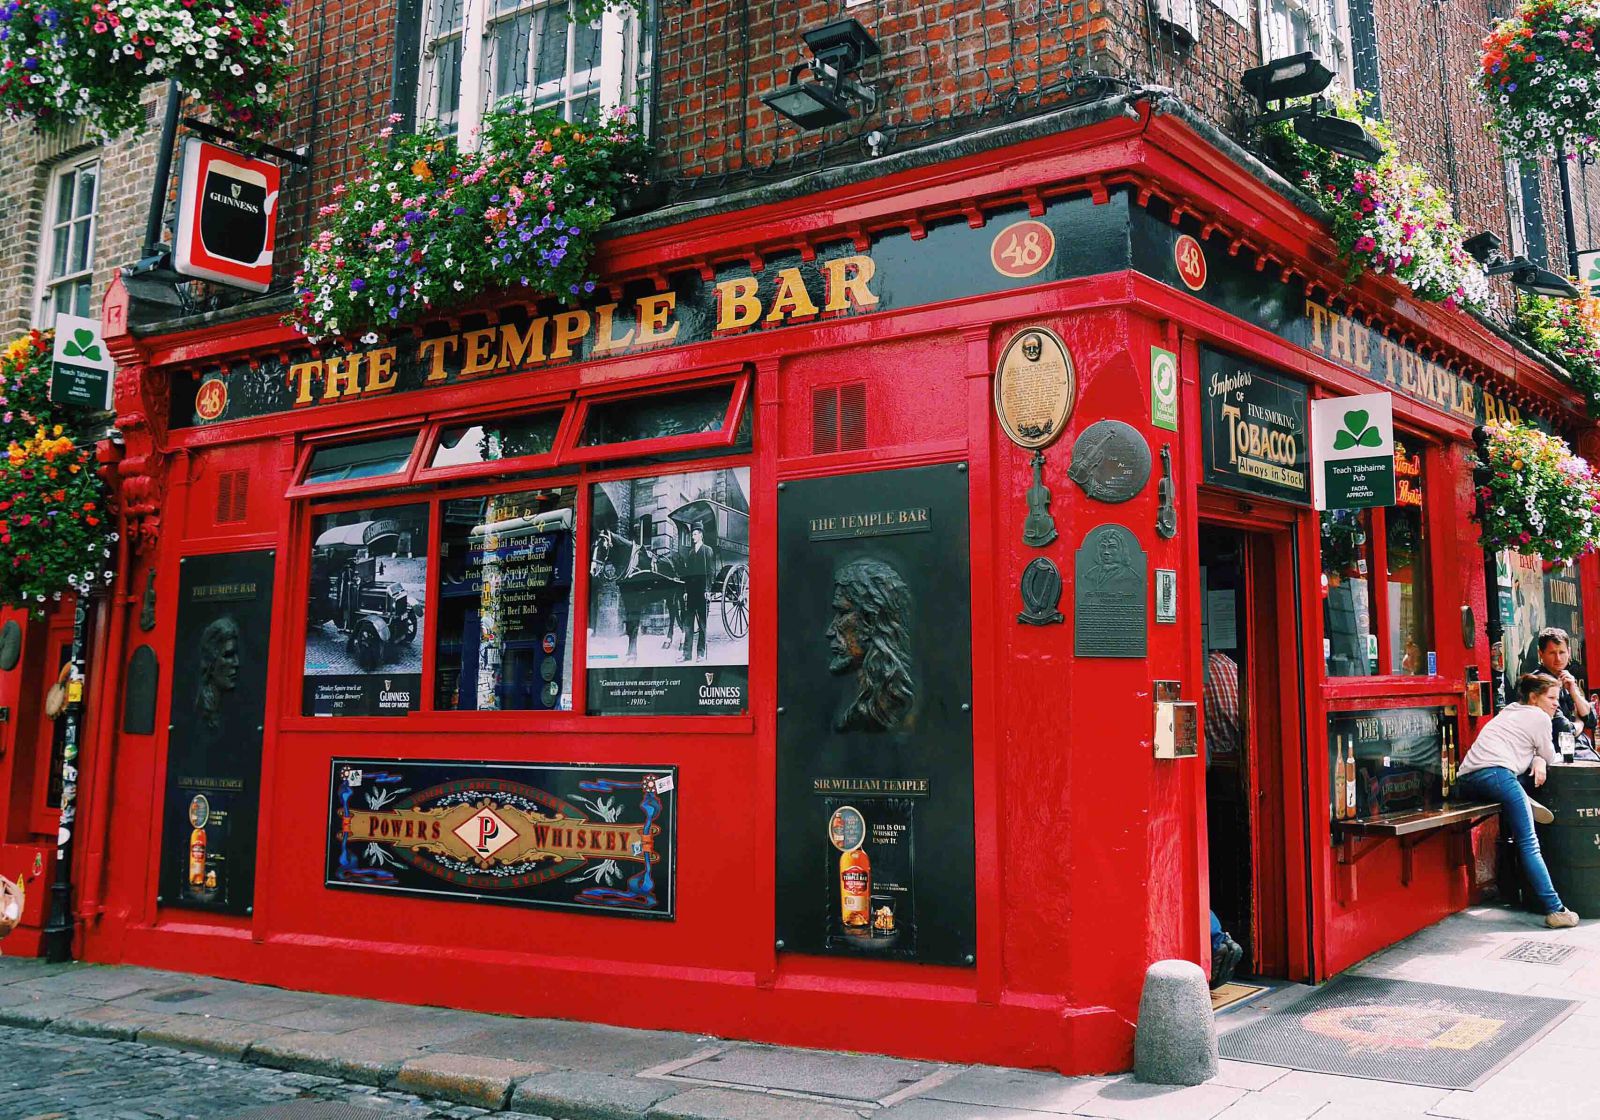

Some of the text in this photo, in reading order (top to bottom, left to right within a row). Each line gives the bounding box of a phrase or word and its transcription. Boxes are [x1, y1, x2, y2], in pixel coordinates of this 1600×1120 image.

[210, 192, 259, 214] GUINNESS
[1001, 233, 1043, 268] 48
[1181, 242, 1200, 278] 48
[289, 255, 879, 404] THE TEMPLE BAR
[1306, 299, 1520, 426] THE TEMPLE BAR
[1209, 370, 1252, 403] Importers
[201, 387, 220, 413] 48
[1236, 392, 1245, 402] OF
[1248, 403, 1295, 429] FINE SMOKING
[1222, 403, 1296, 467] TOBACCO
[1240, 460, 1303, 486] Always in Stock
[810, 509, 927, 531] THE TEMPLE BAR
[510, 537, 528, 546] Food
[530, 536, 546, 545] Fare
[506, 553, 525, 561] Cheese
[528, 551, 545, 560] Board
[465, 570, 480, 579] Fresh
[506, 566, 529, 575] Smoked
[530, 564, 553, 574] Salmon
[527, 578, 545, 587] Olives
[502, 594, 536, 602] Sandwiches
[508, 607, 520, 615] Beef
[523, 605, 538, 614] Rolls
[638, 679, 669, 687] messenger's
[644, 689, 668, 697] uniform"
[699, 685, 740, 698] GUINNESS
[380, 691, 410, 702] GUINNESS
[1356, 718, 1379, 741] THE
[460, 782, 493, 790] LANE
[814, 779, 927, 791] SIR WILLIAM TEMPLE
[368, 816, 441, 839] POWERS
[476, 816, 499, 853] P
[533, 823, 631, 851] WHISKEY
[873, 837, 889, 845] ENJOY
[512, 868, 556, 887] STILL
